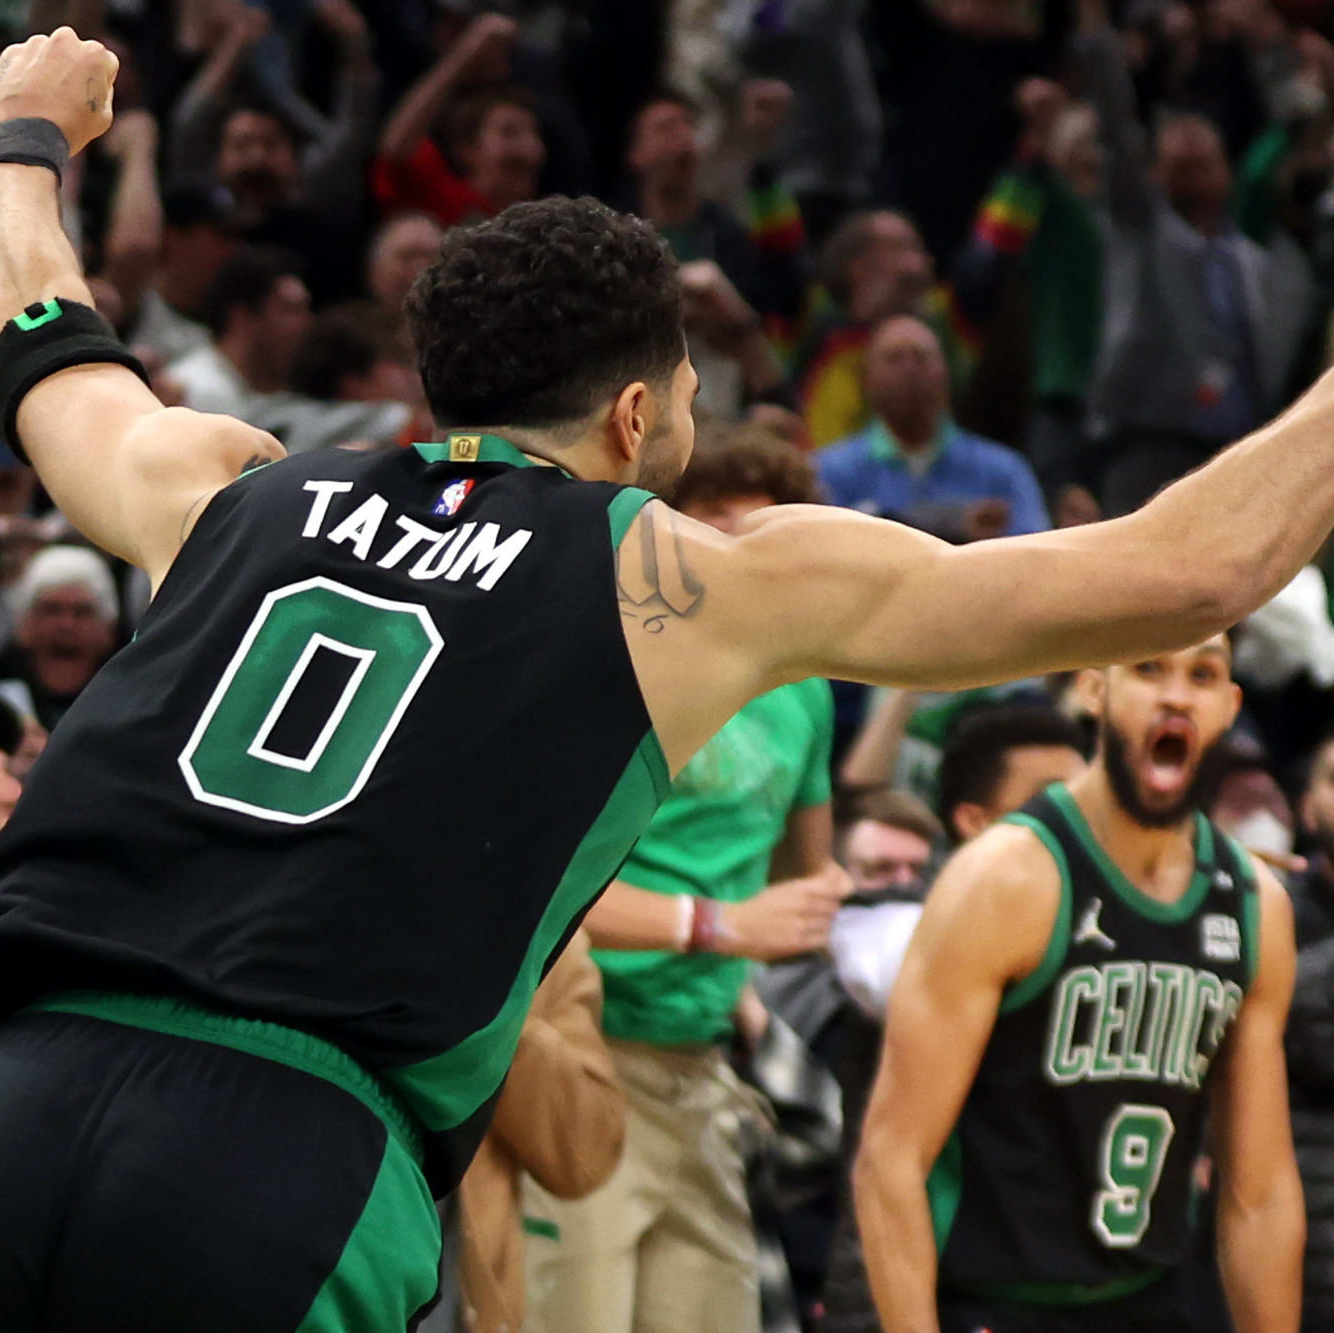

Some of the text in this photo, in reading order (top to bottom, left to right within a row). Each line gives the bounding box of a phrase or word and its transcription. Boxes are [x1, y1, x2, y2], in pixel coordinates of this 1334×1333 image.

[301, 479, 533, 592] TATUM
[177, 575, 445, 825] 0
[1090, 1103, 1176, 1248] 9
